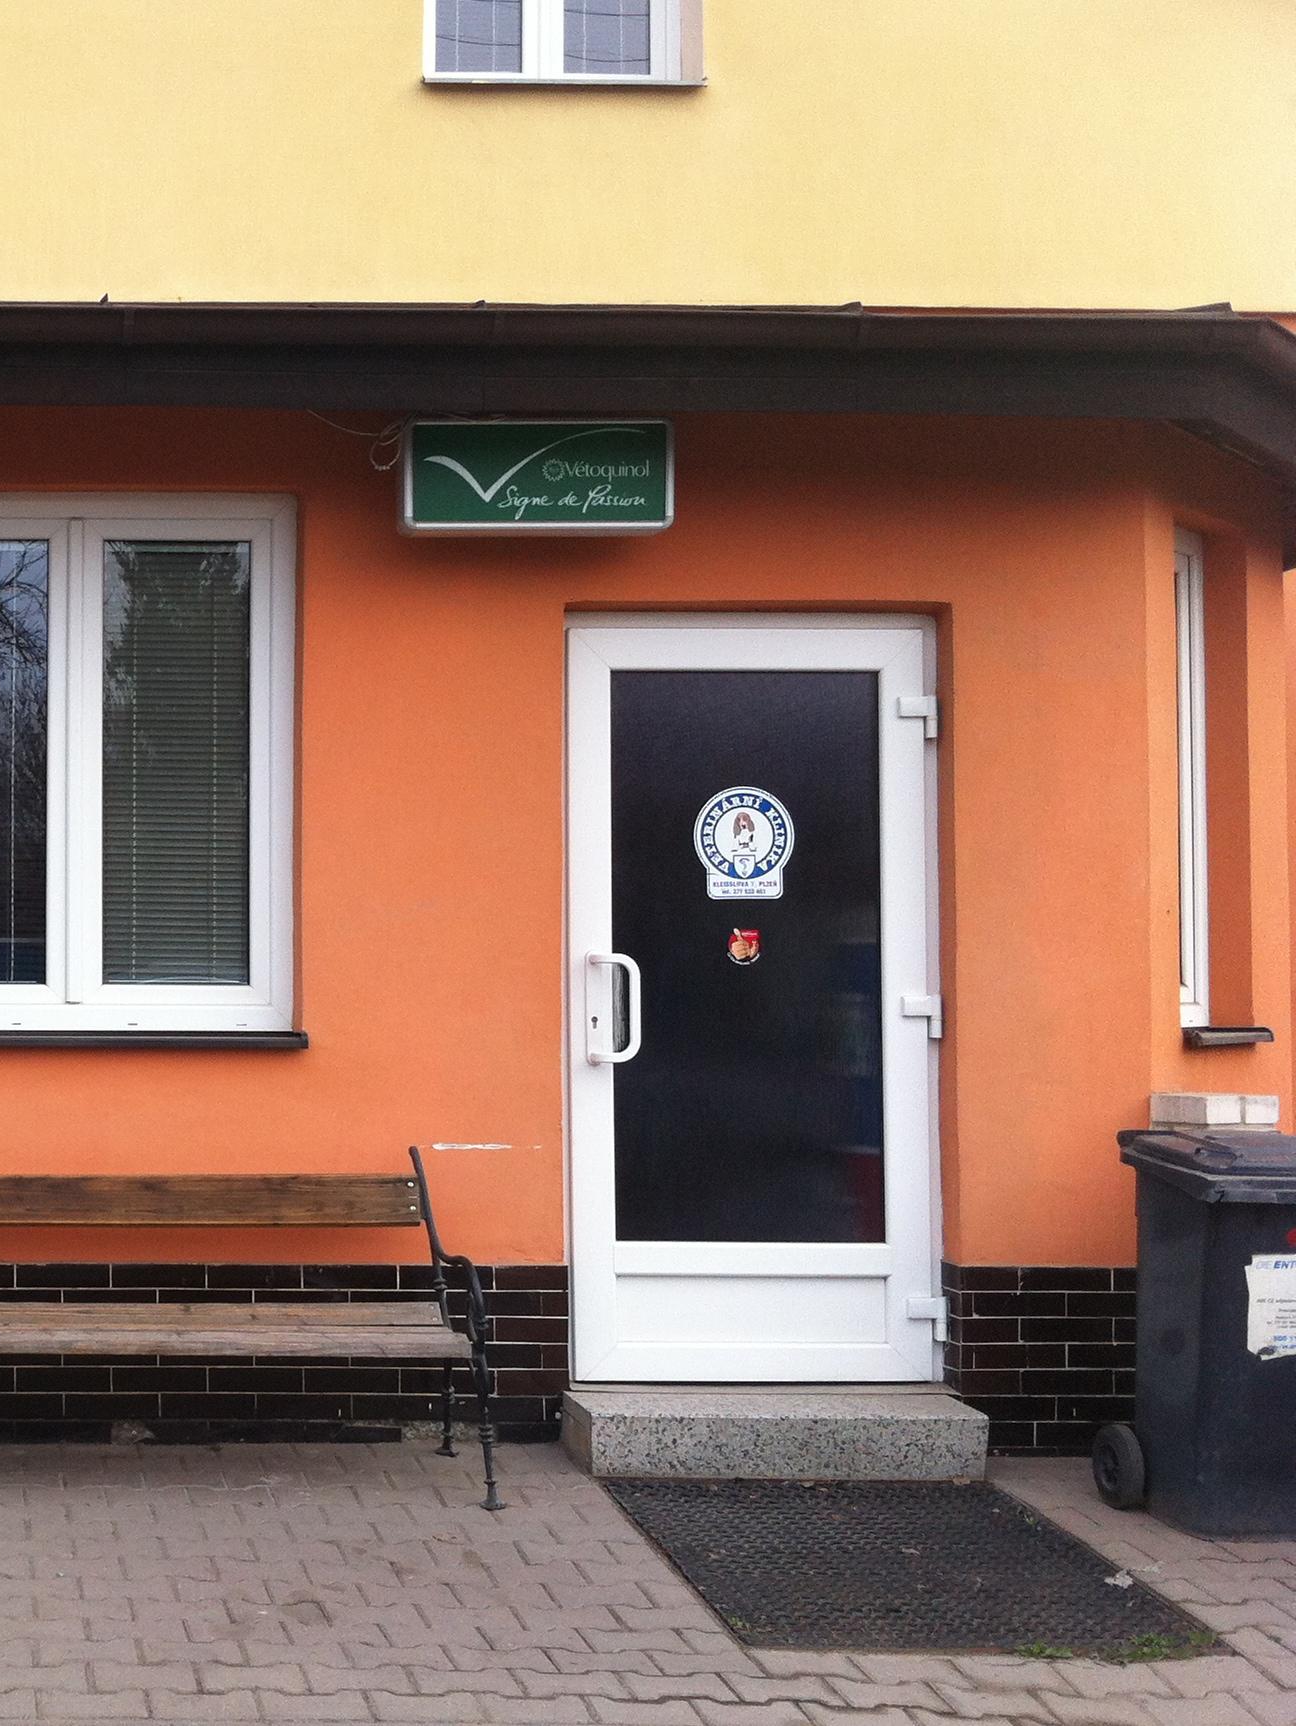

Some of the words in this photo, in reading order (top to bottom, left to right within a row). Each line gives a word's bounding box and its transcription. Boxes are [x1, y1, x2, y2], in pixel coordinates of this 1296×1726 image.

[565, 459, 650, 482] Vétoquinol
[497, 485, 554, 520] Signe
[557, 491, 581, 507] de
[582, 484, 646, 514] Passion
